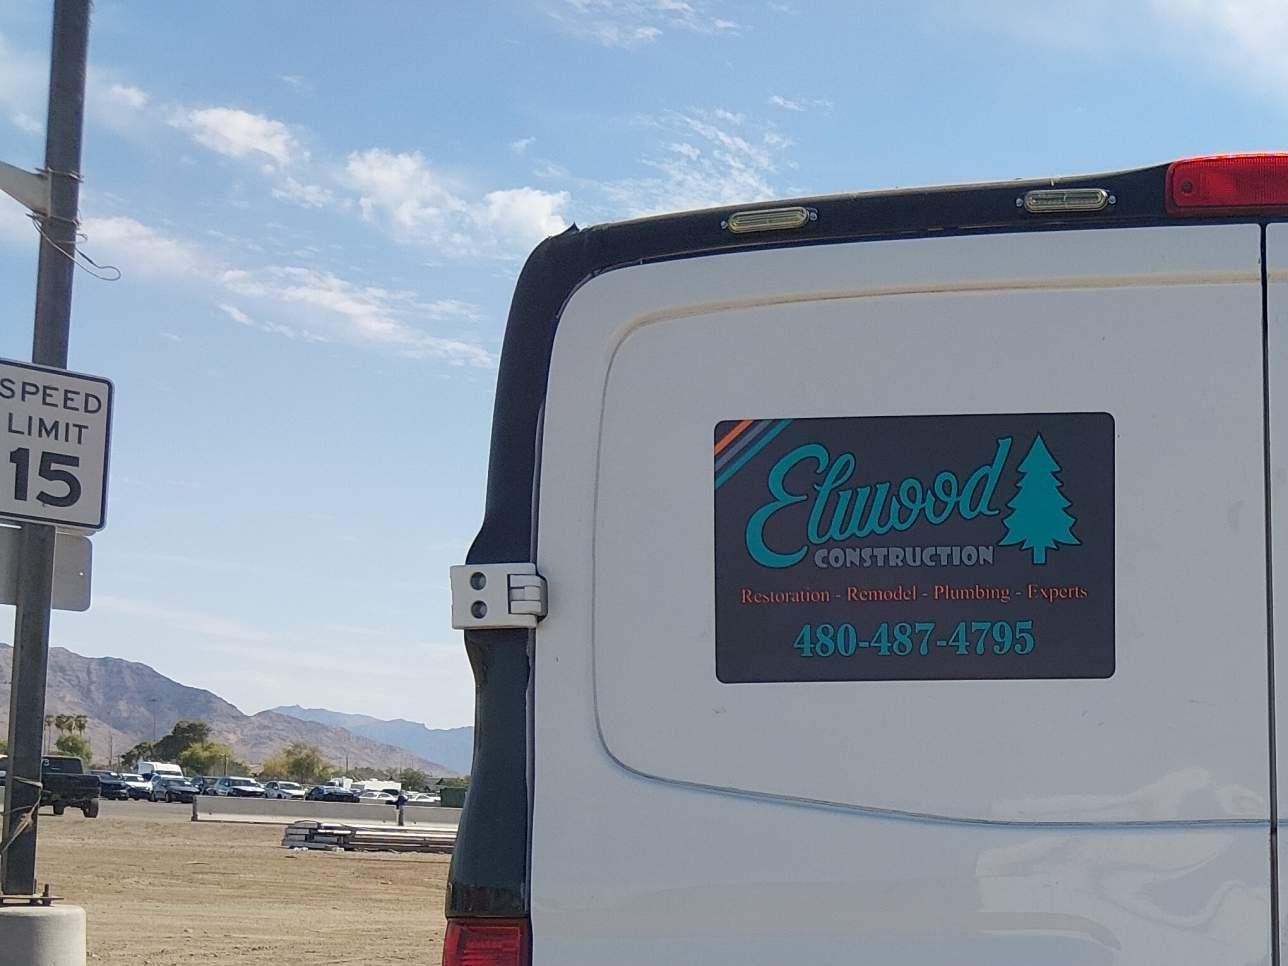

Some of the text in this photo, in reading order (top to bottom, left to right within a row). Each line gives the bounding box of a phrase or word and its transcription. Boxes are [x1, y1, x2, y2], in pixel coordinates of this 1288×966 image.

[0, 378, 102, 414] SPEED
[8, 412, 89, 445] LIMIT
[9, 447, 82, 507] 15
[745, 435, 1013, 568] Elwood
[814, 545, 994, 568] CONSTRUCTION
[741, 587, 831, 604] Restoration
[847, 585, 917, 602] Remodel
[934, 583, 1010, 603] Plumbing
[1027, 583, 1089, 602] Experts
[793, 620, 1036, 657] 480-487-4795
